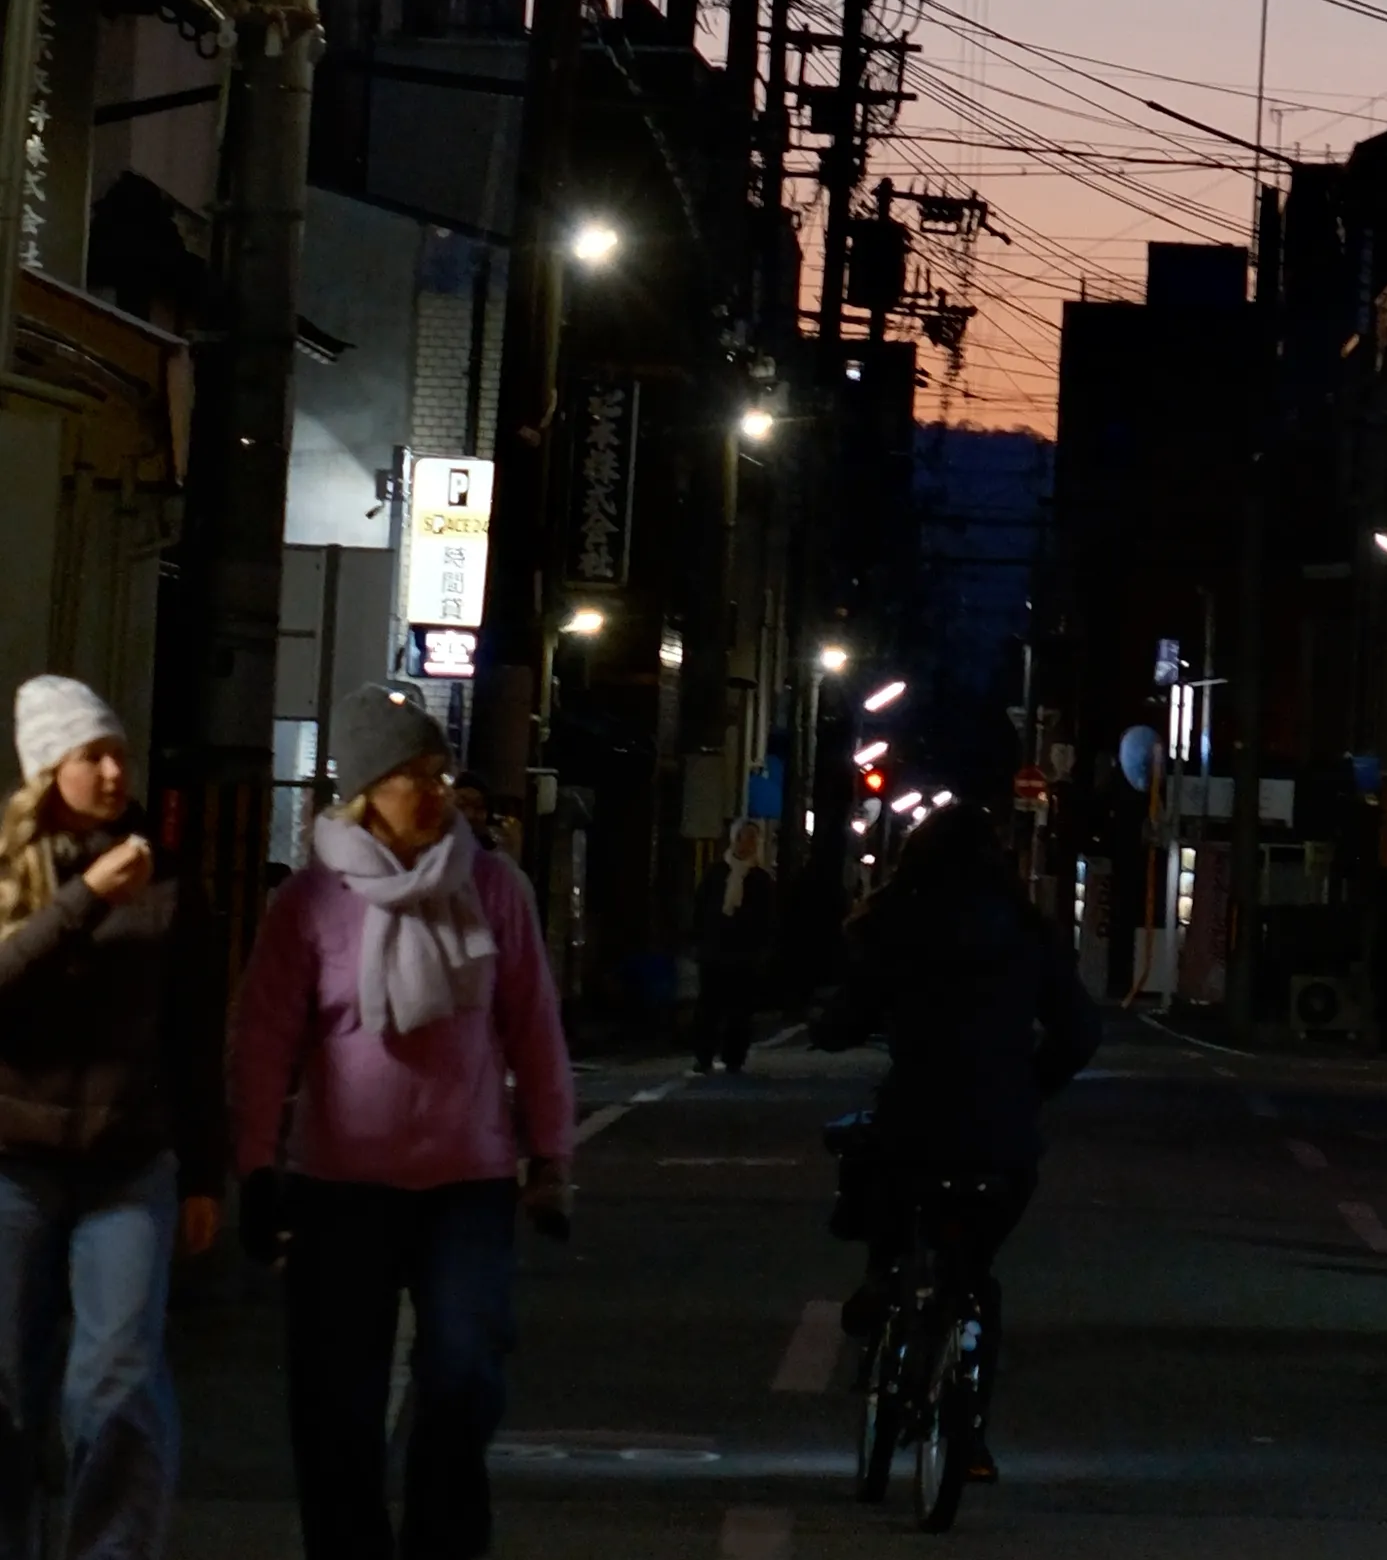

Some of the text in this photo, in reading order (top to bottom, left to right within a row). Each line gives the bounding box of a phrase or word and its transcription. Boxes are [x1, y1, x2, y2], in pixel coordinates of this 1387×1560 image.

[449, 470, 470, 505] P
[439, 545, 466, 621] 時間貸
